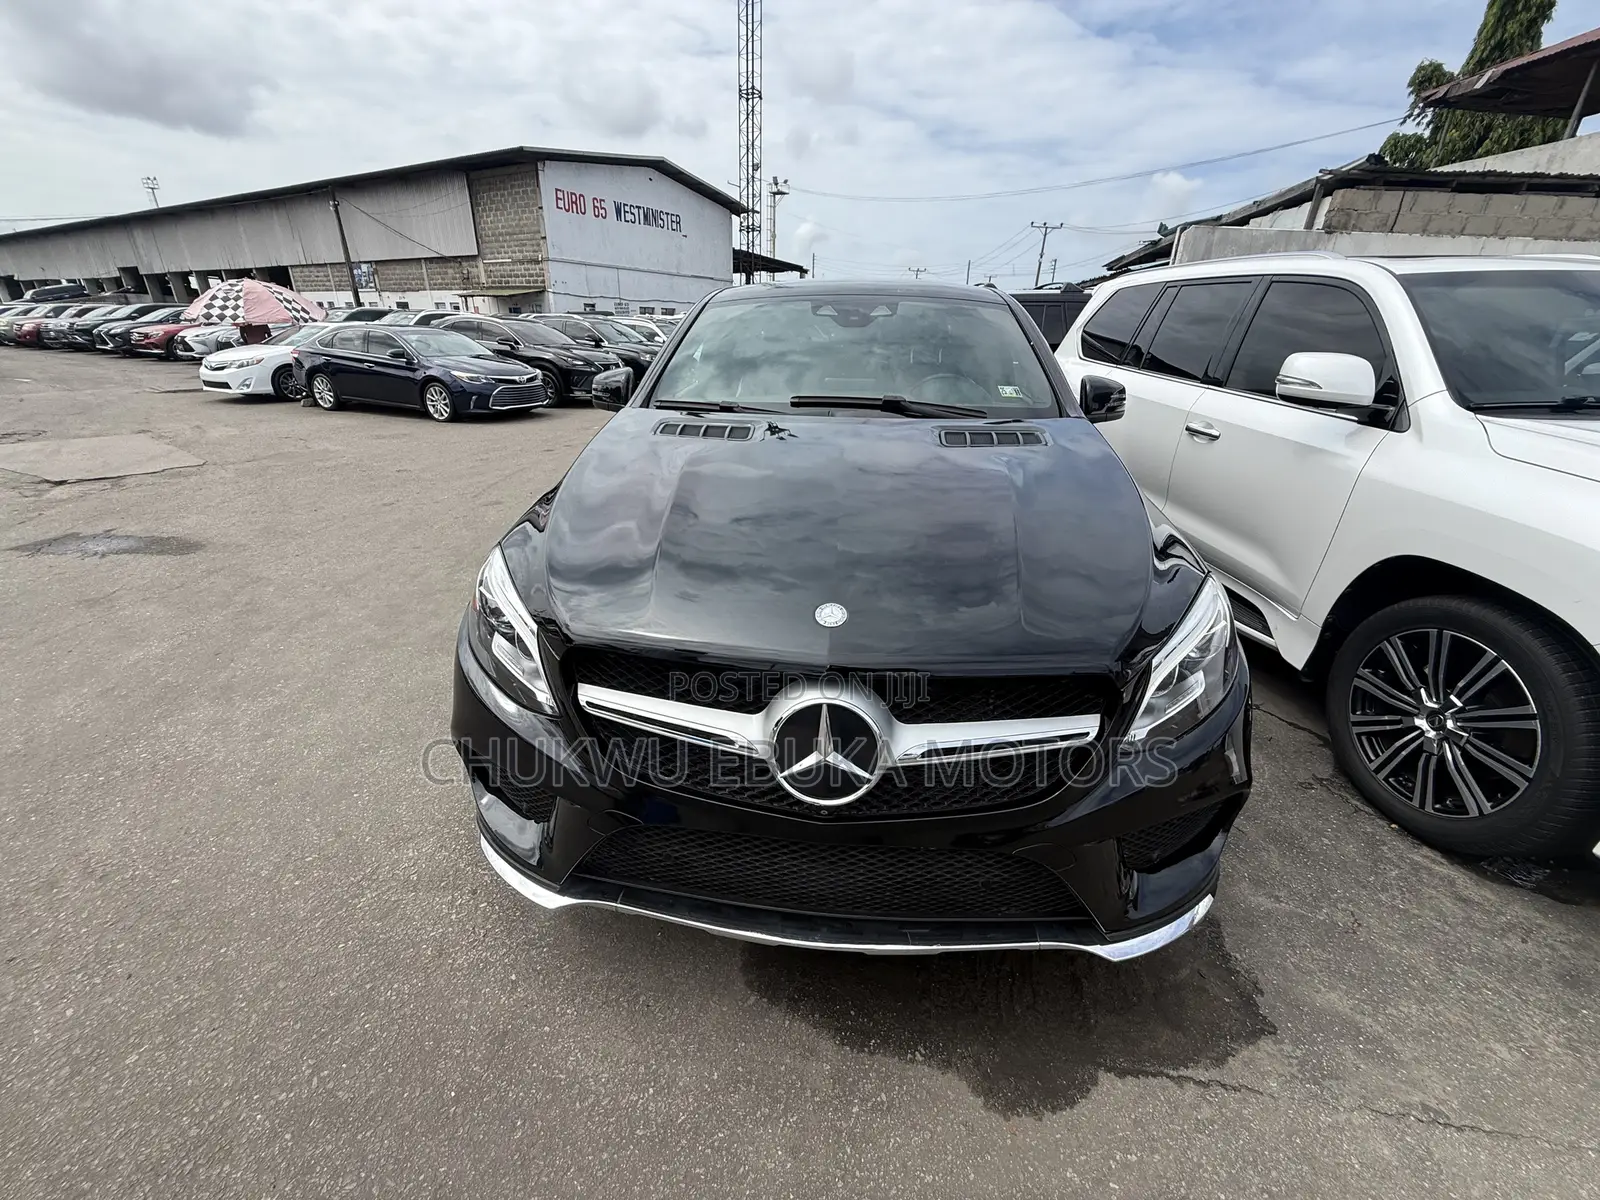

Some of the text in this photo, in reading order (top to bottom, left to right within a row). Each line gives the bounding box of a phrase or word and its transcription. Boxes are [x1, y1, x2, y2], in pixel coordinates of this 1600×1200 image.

[554, 187, 682, 233] EURO 65 WESTMINISTER
